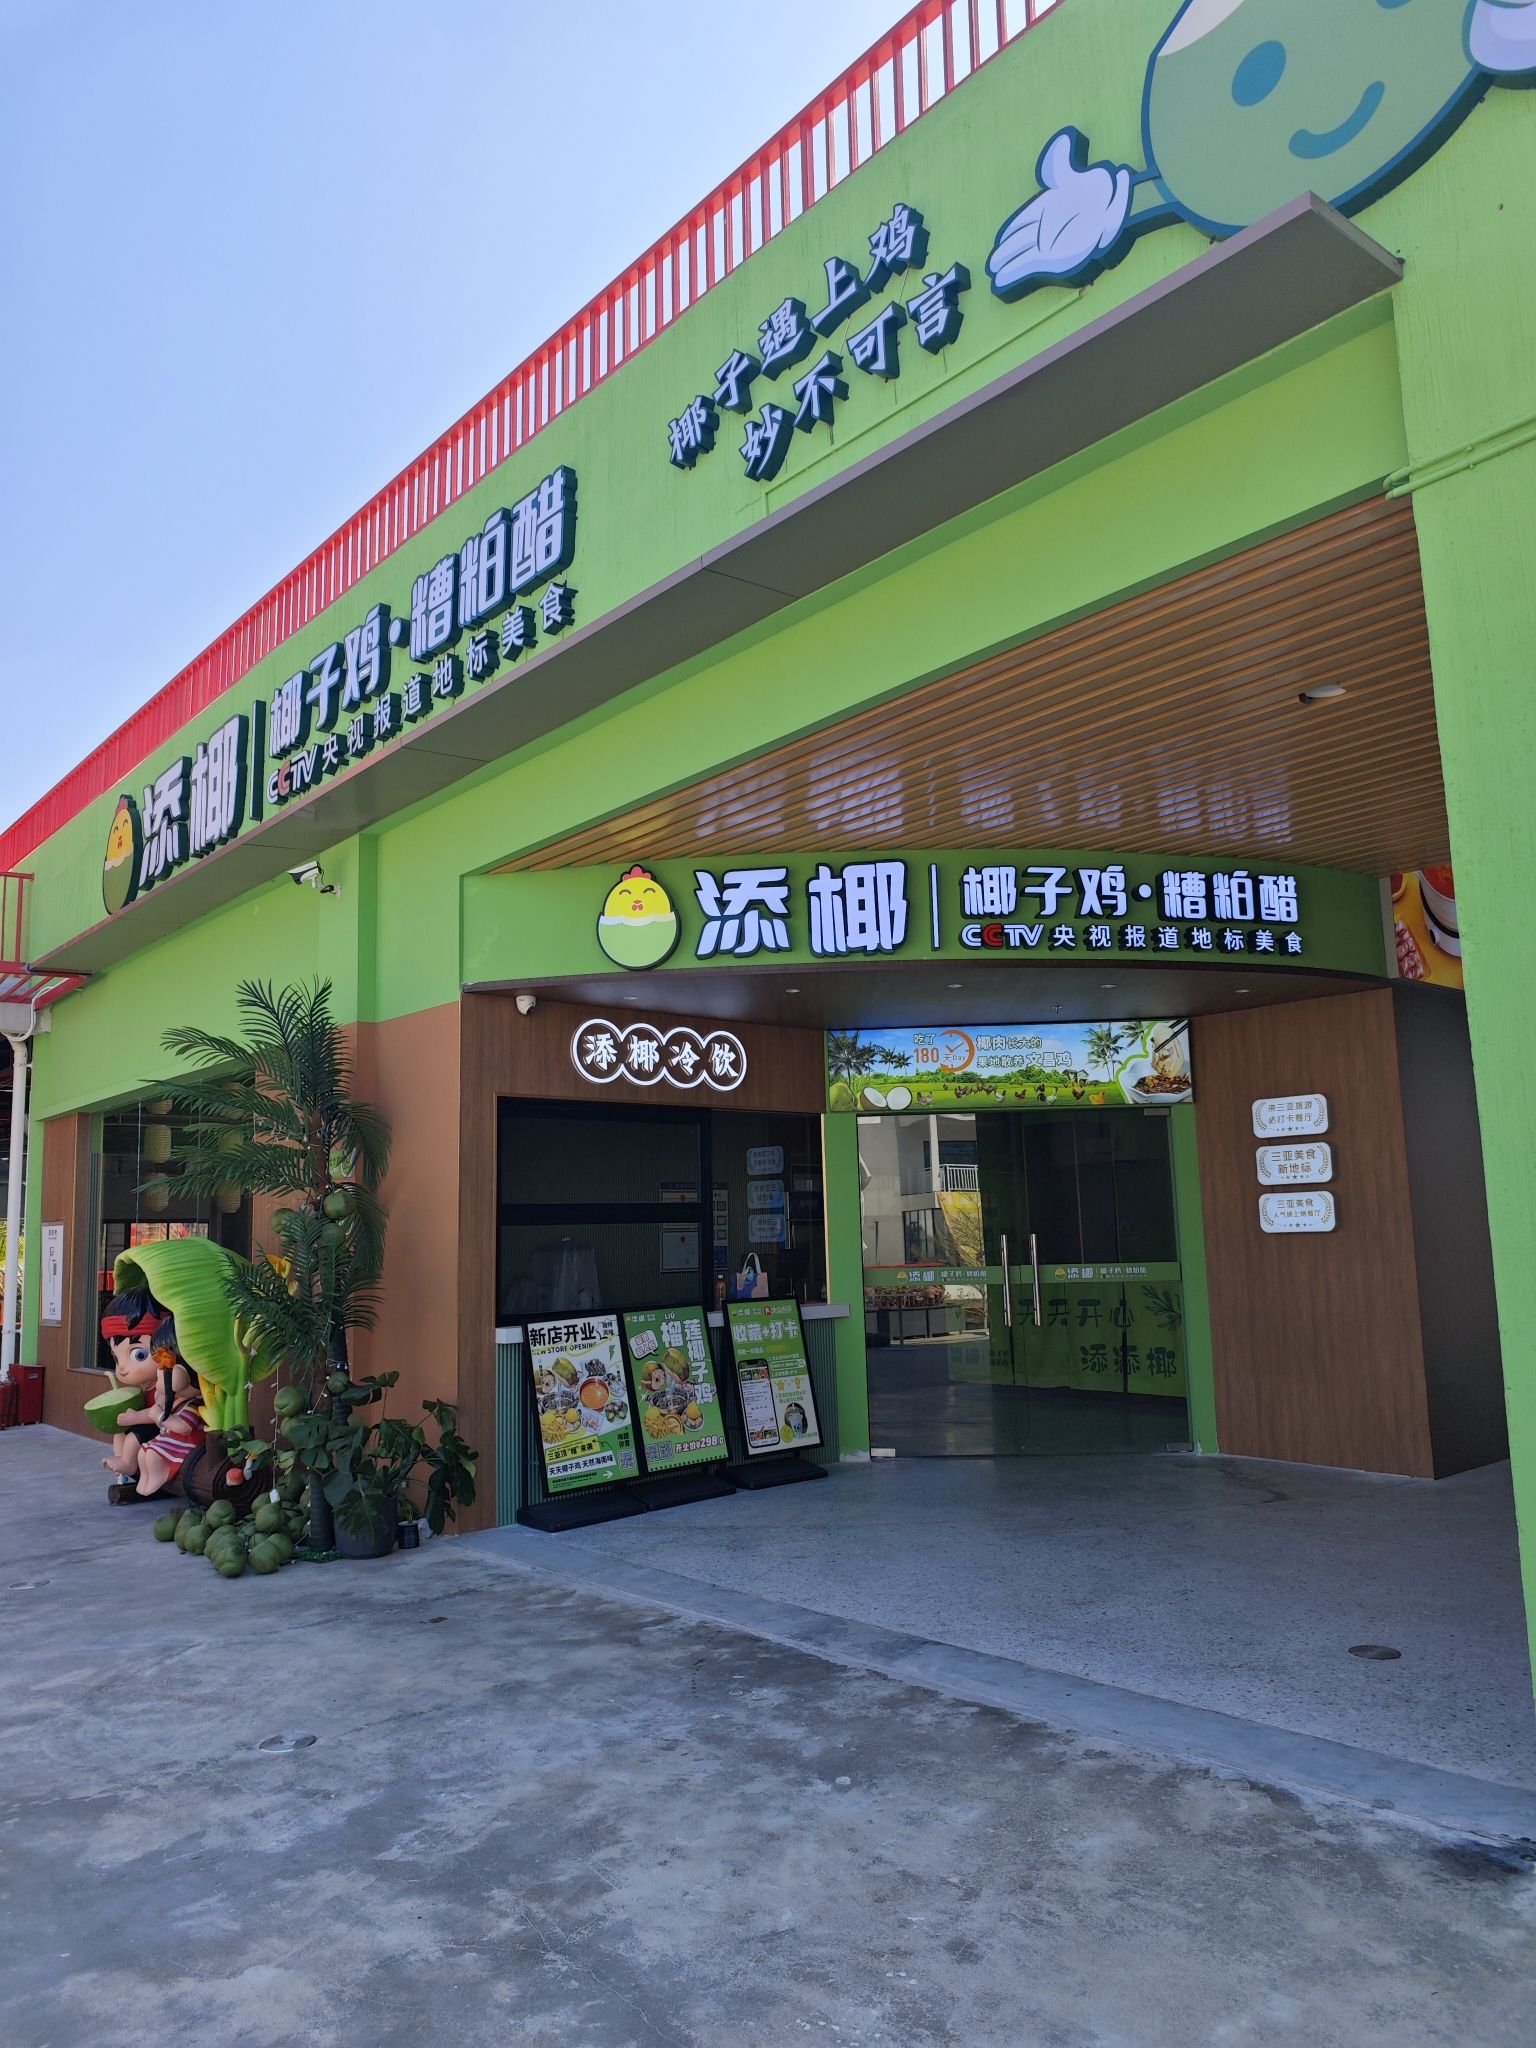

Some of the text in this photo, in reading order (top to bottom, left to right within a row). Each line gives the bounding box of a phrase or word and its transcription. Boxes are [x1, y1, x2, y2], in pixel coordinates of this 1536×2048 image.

[668, 203, 931, 469] 椰子遇上鸡
[740, 262, 971, 482] 妙不可言
[138, 713, 248, 890] 添椰
[694, 860, 910, 958] 添椰
[913, 1033, 936, 1046] 吃了
[583, 1030, 740, 1079] 添椰冷饮
[913, 1047, 940, 1064] 180
[1268, 1112, 1313, 1125] 必打卡餐厅
[1271, 1148, 1316, 1162] 三亚美食
[1278, 1162, 1312, 1175] 新地标
[1277, 1198, 1314, 1209] 三亚美食
[529, 1321, 597, 1347] 新店开业
[547, 1345, 568, 1354] STORE
